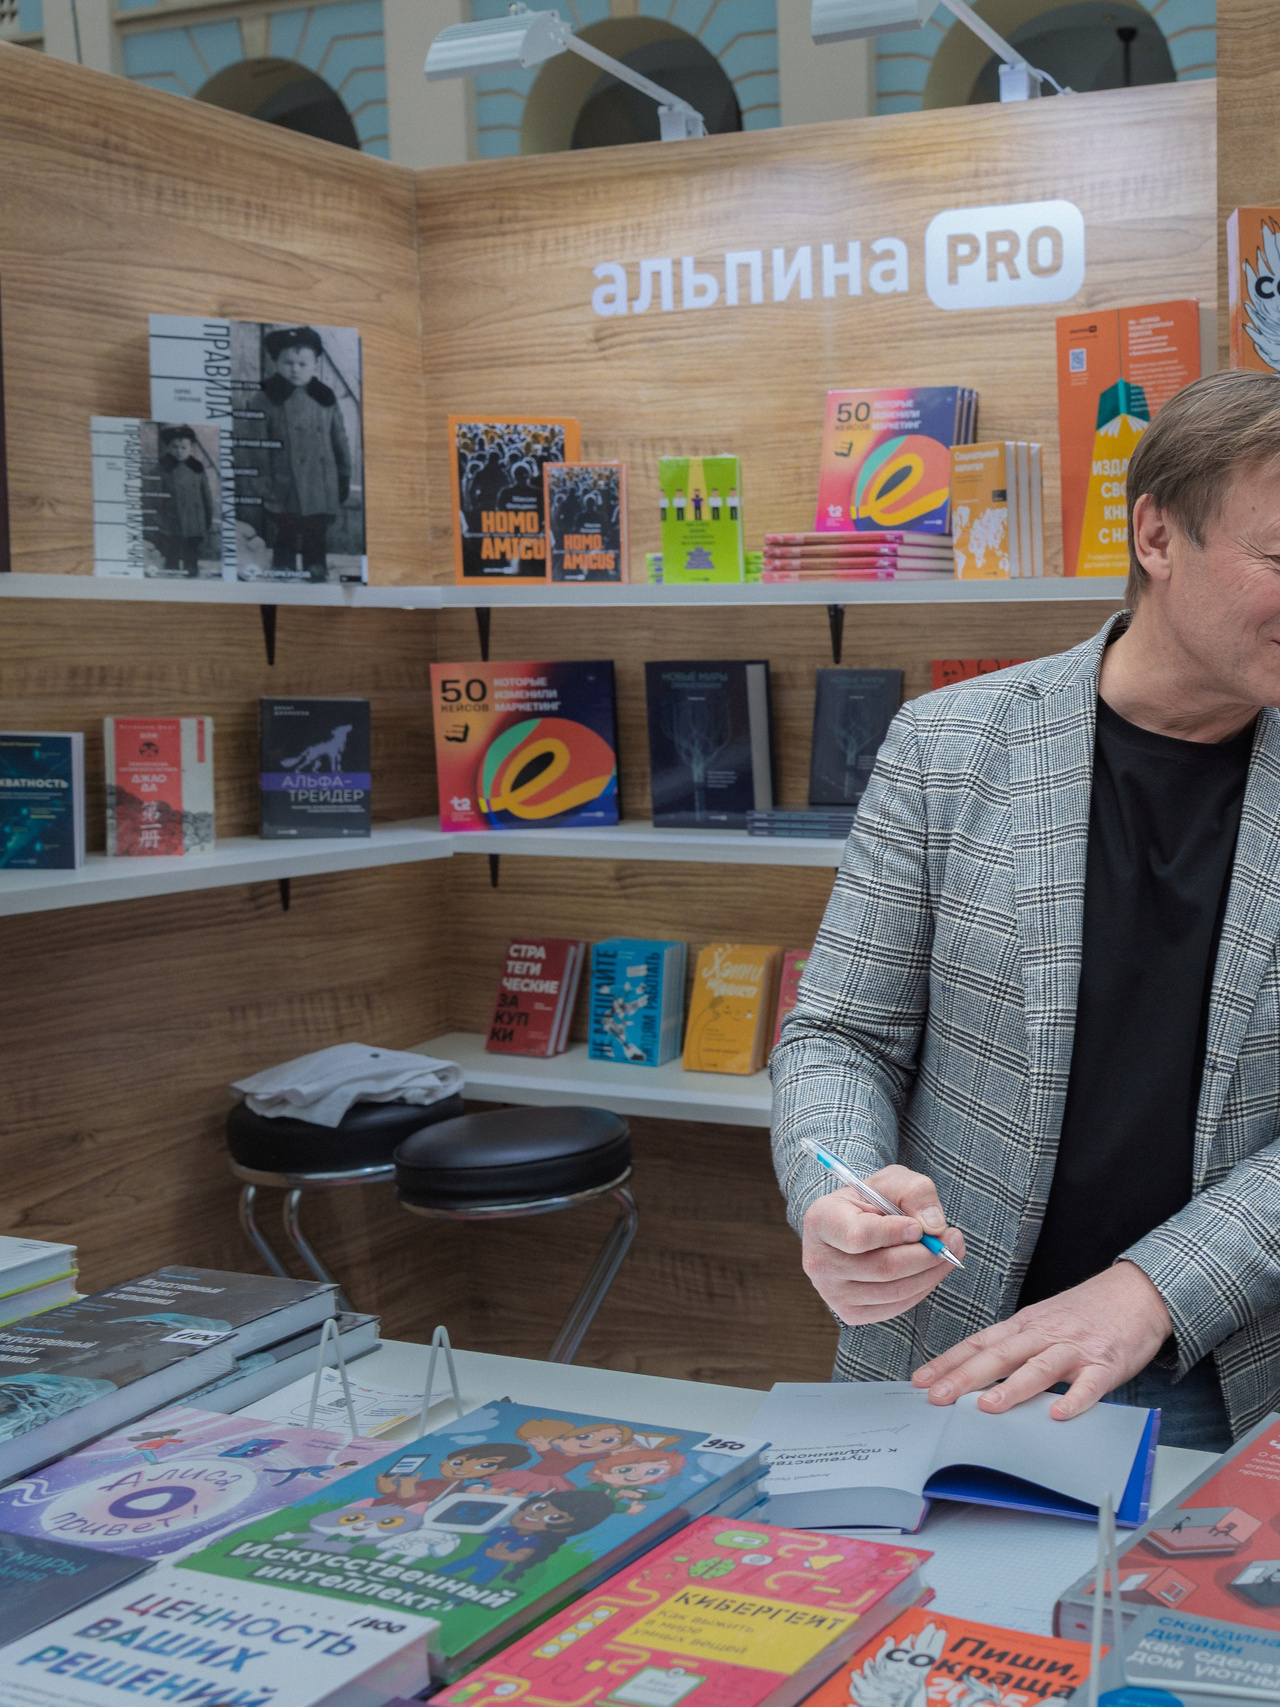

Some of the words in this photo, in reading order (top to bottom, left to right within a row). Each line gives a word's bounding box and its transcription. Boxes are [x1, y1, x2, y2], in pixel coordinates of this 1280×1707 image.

[591, 237, 909, 317] альпина
[946, 225, 1063, 286] PRO
[203, 323, 233, 420] ПРАВИЛА
[836, 402, 871, 422] 50
[481, 511, 539, 533] HOMO
[564, 534, 602, 550] HOMO
[563, 553, 615, 570] AMICUS
[441, 678, 487, 702] 50
[493, 677, 548, 687] КОТОРЫЕ
[494, 689, 558, 699] ИЗМЕНИЛИ
[441, 703, 490, 712] КЕЙСОВ
[494, 702, 561, 712] МАРКЕТИНГ
[131, 773, 167, 783] ДЖАО
[281, 774, 352, 788] АЛЬФА-
[288, 788, 365, 803] ТРЕЙДЕР
[508, 944, 546, 960] СТРА
[507, 960, 542, 976] ТЕГИ
[502, 977, 560, 995] ЧЕСКИЕ
[498, 993, 519, 1008] ЗА
[494, 1010, 529, 1027] КУП
[490, 1027, 514, 1043] КИ
[702, 1438, 745, 1450] 950
[775, 1447, 882, 1460] подлинному
[97, 1467, 243, 1492] Алиса,
[4, 1551, 88, 1575] МИРЫ
[123, 1593, 357, 1657] ЦЕННОСТЬ
[73, 1617, 270, 1673] ВАШИХ
[949, 1636, 1081, 1681] Пиши,
[16, 1645, 278, 1707] РЕШЕНИЙ
